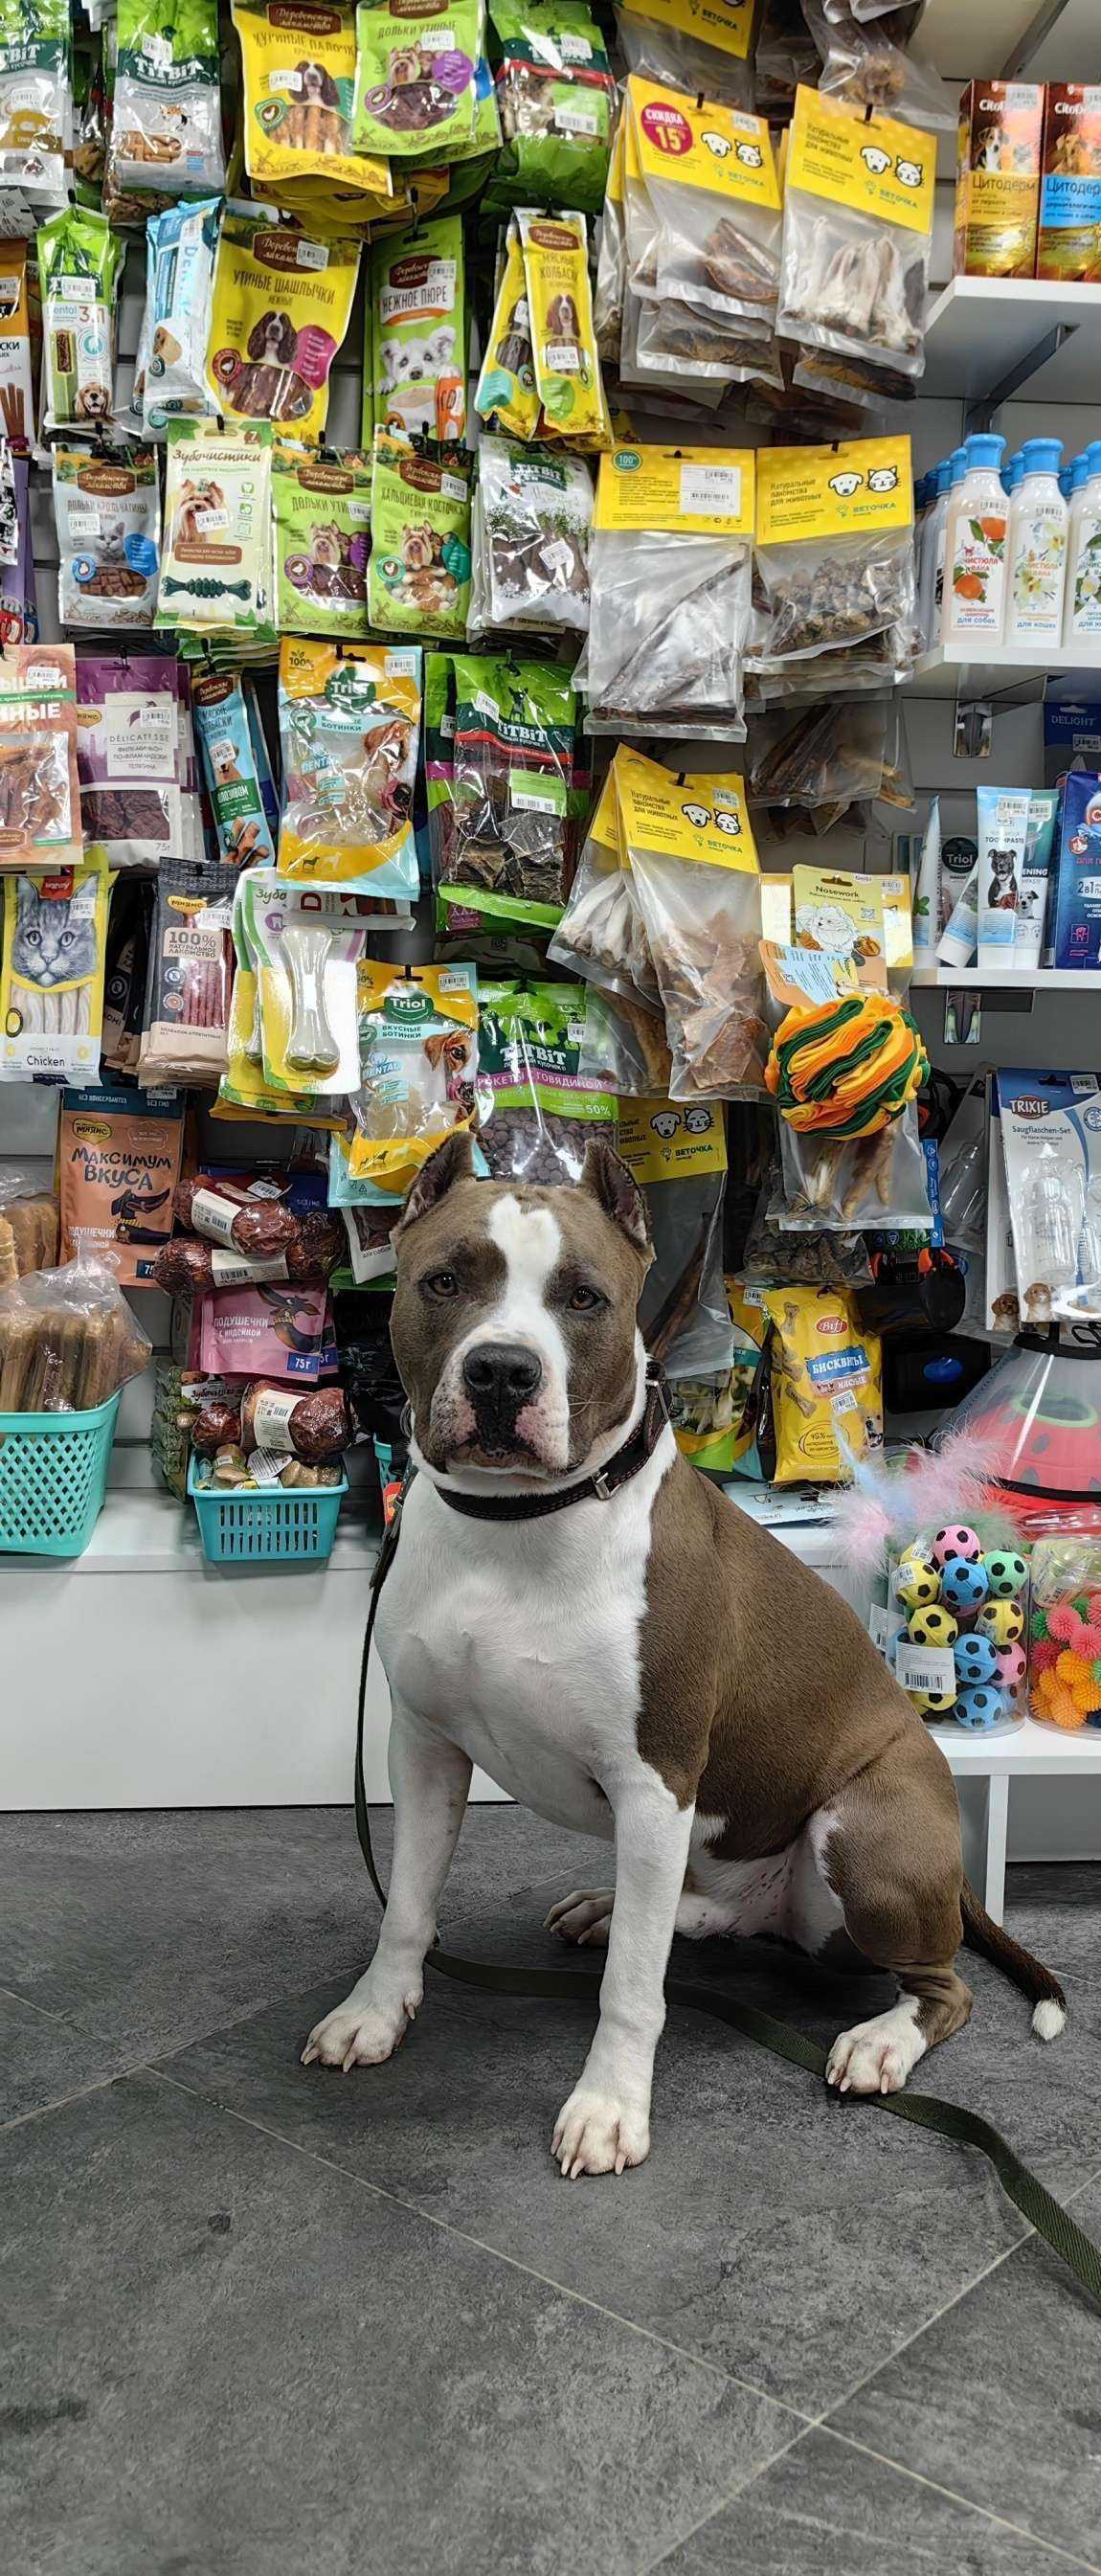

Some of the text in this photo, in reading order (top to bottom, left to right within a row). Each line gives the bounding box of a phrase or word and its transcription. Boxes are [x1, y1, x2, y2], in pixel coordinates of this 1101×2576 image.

[309, 37, 357, 57] ПАЛОЧК
[645, 107, 685, 126] СКИДКА
[971, 174, 1036, 192] Цитодерм
[1045, 175, 1101, 198] Цитодер
[233, 269, 335, 305] УТИНЫЕ ШАШЛЫЧКИ
[382, 284, 448, 314] НЕЖНОЕ ПЮРЕ
[0, 341, 20, 351] СКИ
[291, 496, 328, 512] ДОЛЬКИ
[321, 722, 363, 733] БОТИНКИ
[1050, 714, 1096, 728] DELIGHT
[708, 839, 743, 854] ВЕТОЧКА
[945, 853, 974, 864] Triol
[1022, 868, 1048, 876] ENING
[815, 885, 860, 898] Nosework
[169, 931, 217, 947] 100%
[391, 997, 426, 1009] Triol
[382, 1025, 422, 1033] ВКУСНЫЕ
[27, 1055, 66, 1068] Chicken
[537, 1071, 603, 1089] ГОВЯДИНОЙ
[585, 1104, 612, 1118] 50%
[1010, 1100, 1049, 1114] TRIXIE
[1012, 1125, 1071, 1136] Saugflaschen-Set
[675, 1144, 713, 1157] ВЕТОЧКА
[213, 1316, 270, 1328] ПОДУШЕЧКИ
[224, 1328, 261, 1338] ИНДЕЙКОЙ
[295, 1356, 311, 1369] 75г
[813, 1354, 864, 1374] БИСКВИТЫ
